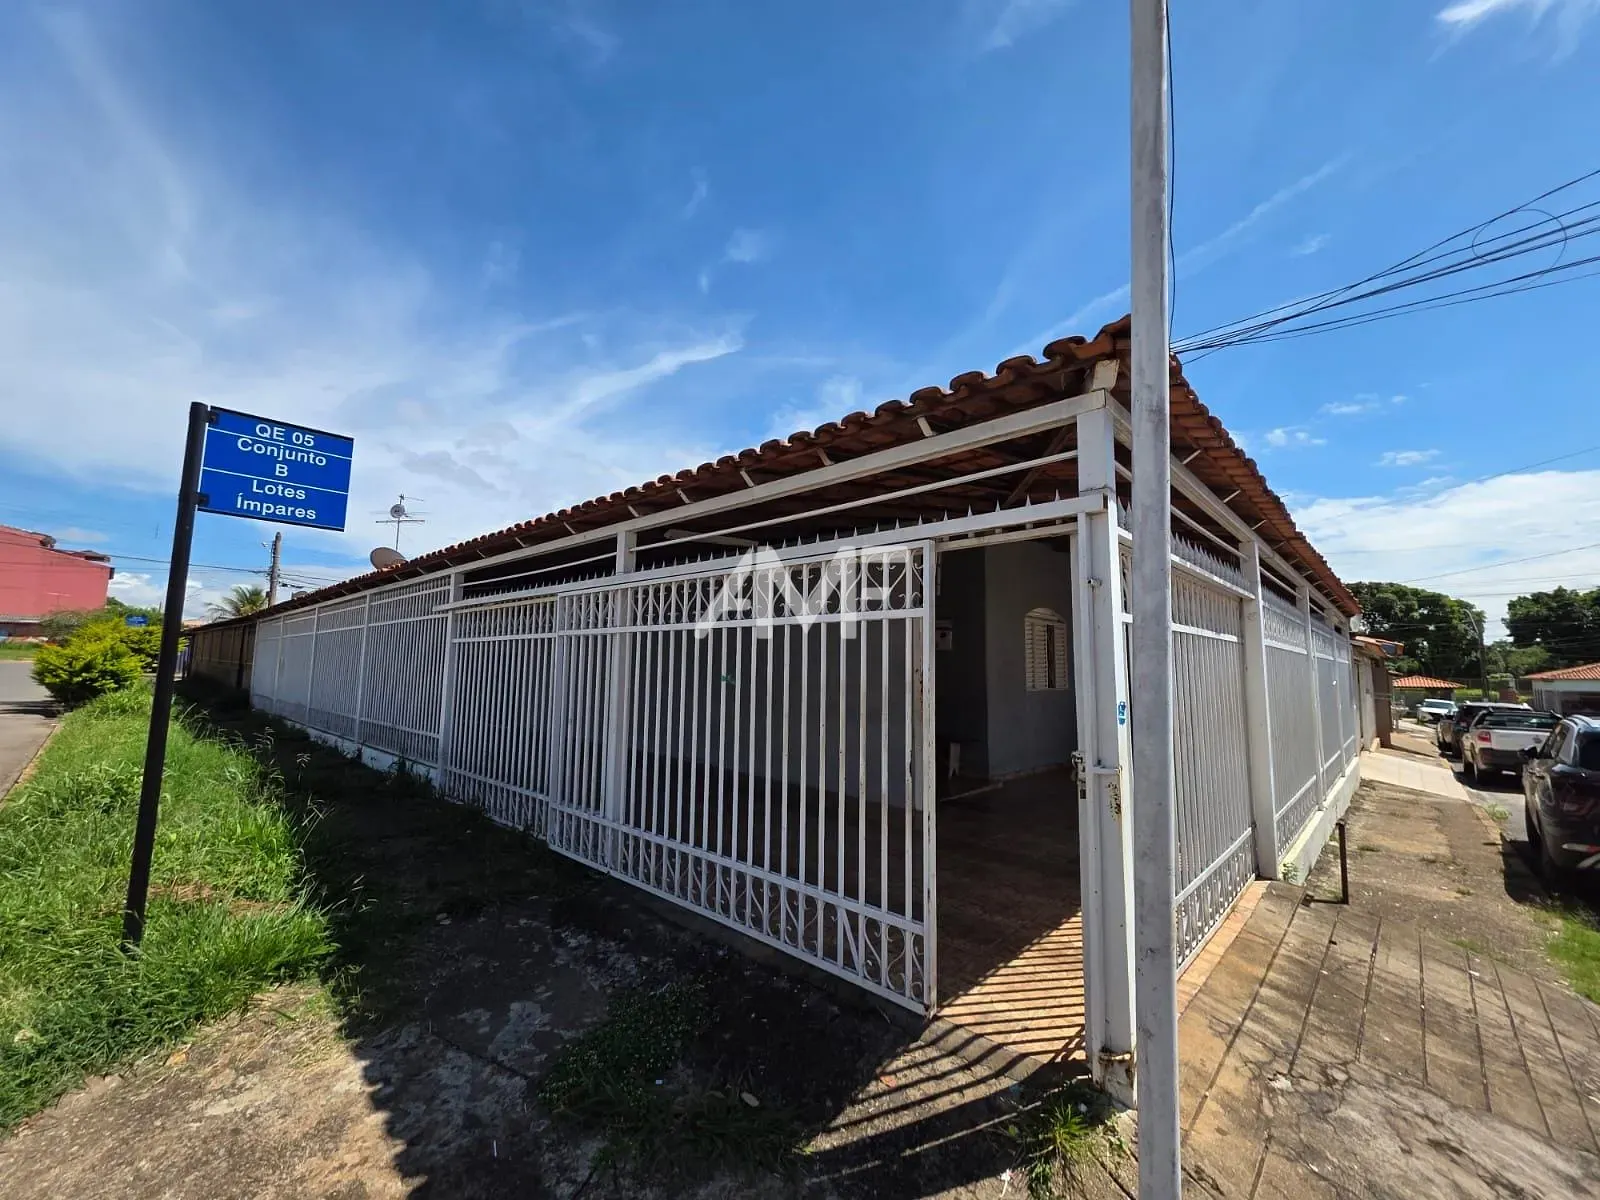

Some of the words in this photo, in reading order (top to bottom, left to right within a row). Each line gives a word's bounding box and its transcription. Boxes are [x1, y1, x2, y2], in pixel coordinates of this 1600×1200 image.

[255, 423, 286, 441] QE
[292, 431, 315, 447] 05
[237, 437, 327, 466] Conjunto
[275, 464, 288, 477] B
[252, 480, 306, 500] Lotes
[236, 493, 316, 520] Ímpares
